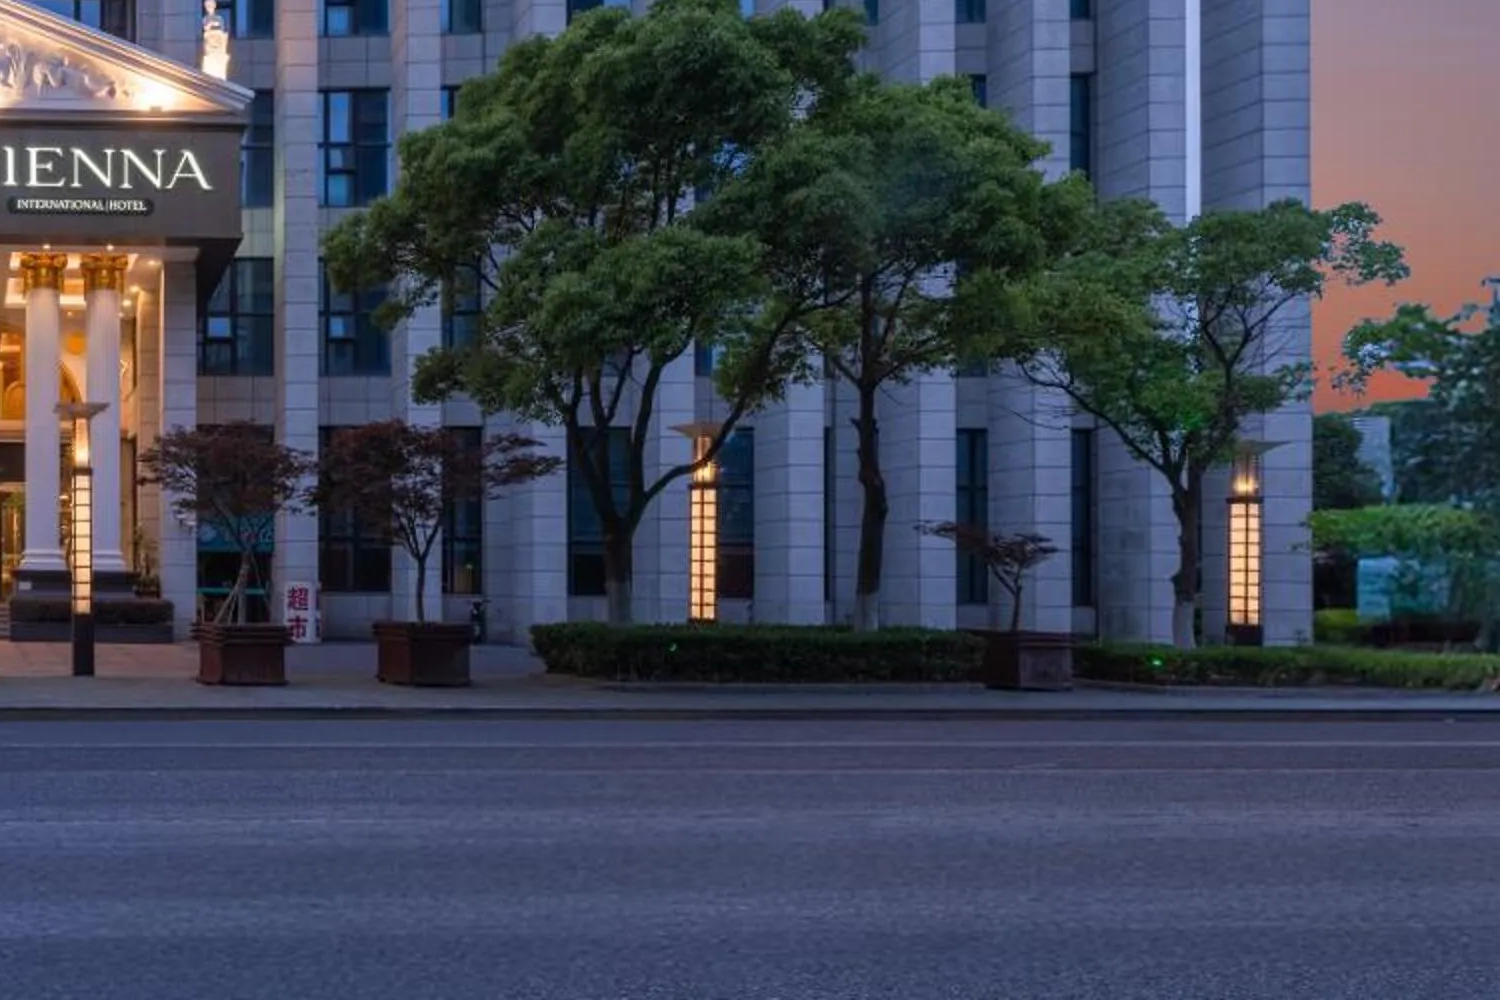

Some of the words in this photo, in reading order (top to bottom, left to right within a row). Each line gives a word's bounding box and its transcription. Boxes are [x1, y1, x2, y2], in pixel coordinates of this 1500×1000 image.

[16, 199, 104, 211] INTERNATIONAL
[108, 200, 148, 212] HOTEL
[286, 586, 309, 638] 超市
